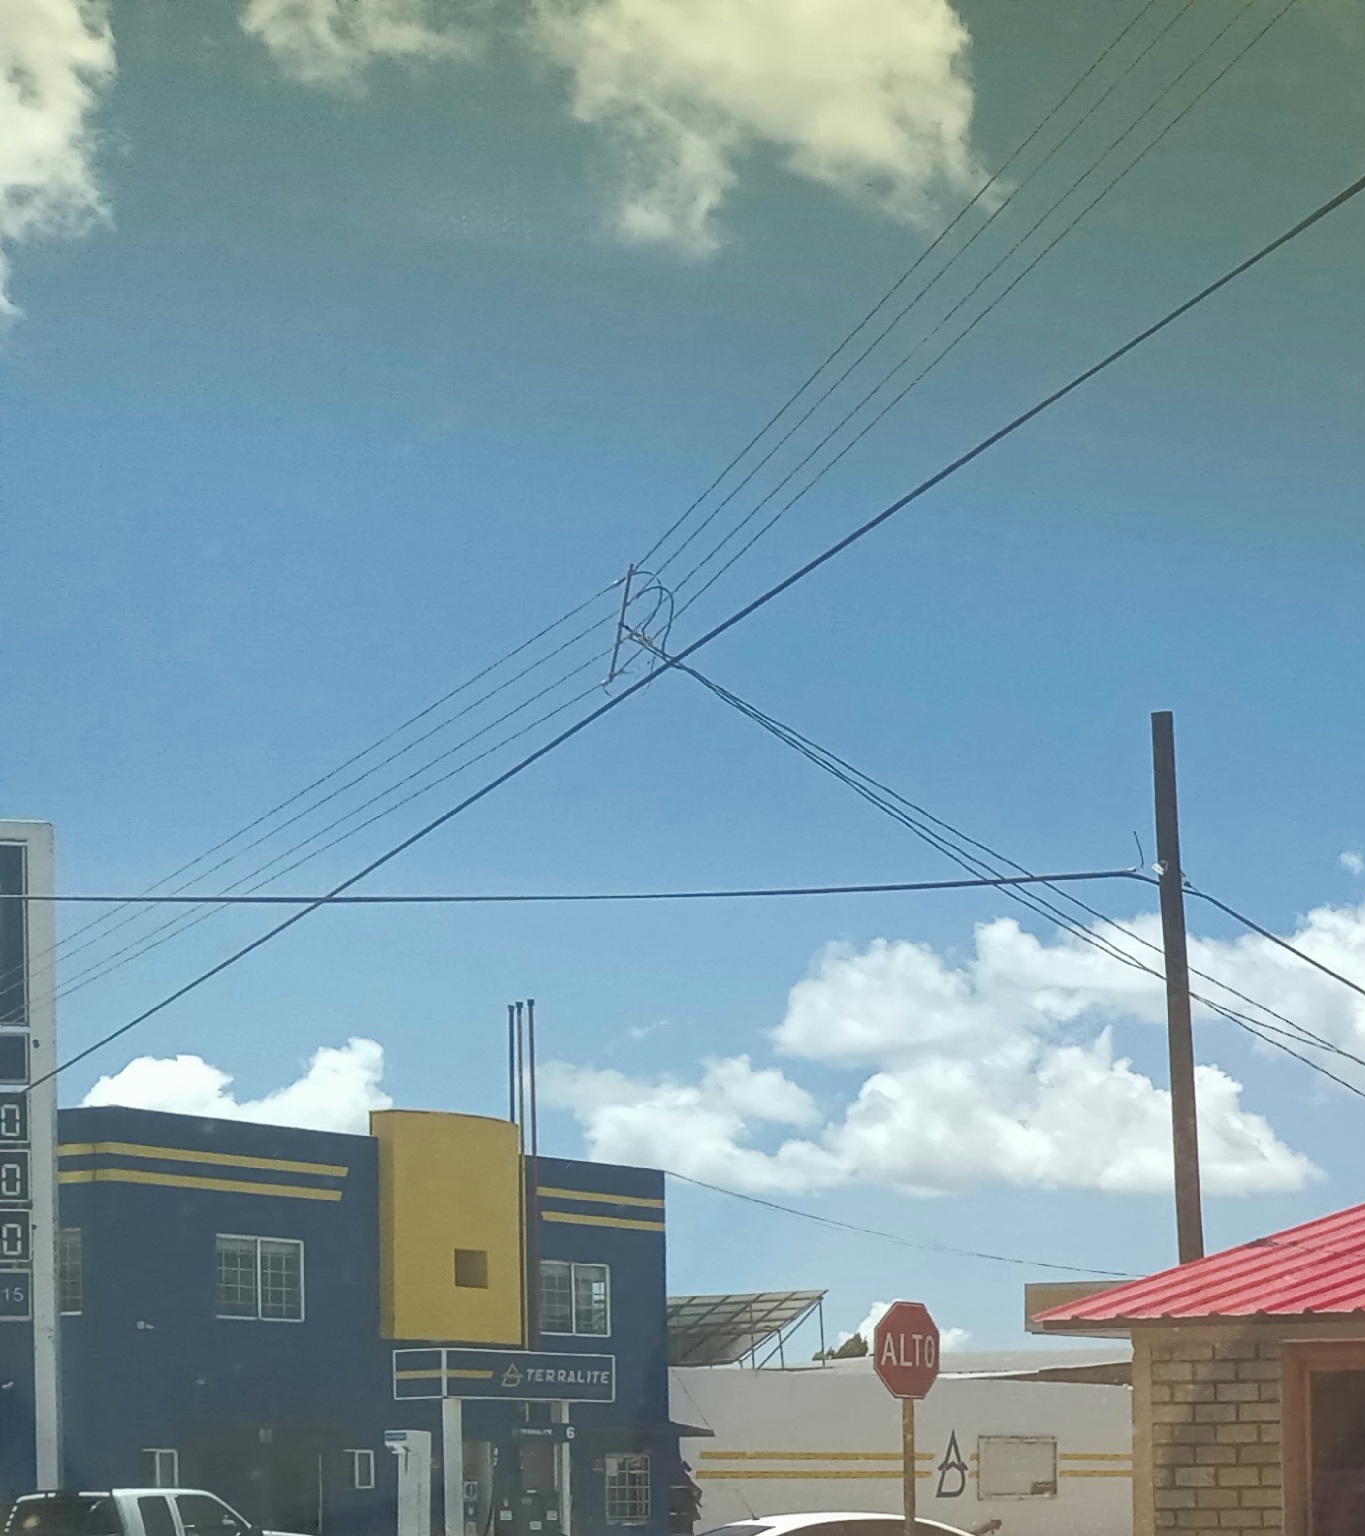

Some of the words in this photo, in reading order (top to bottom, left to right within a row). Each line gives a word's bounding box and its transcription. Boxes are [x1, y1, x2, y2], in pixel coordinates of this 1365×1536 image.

[880, 1331, 935, 1368] ALTO
[526, 1368, 610, 1385] TERRALITE
[565, 1426, 576, 1440] 6
